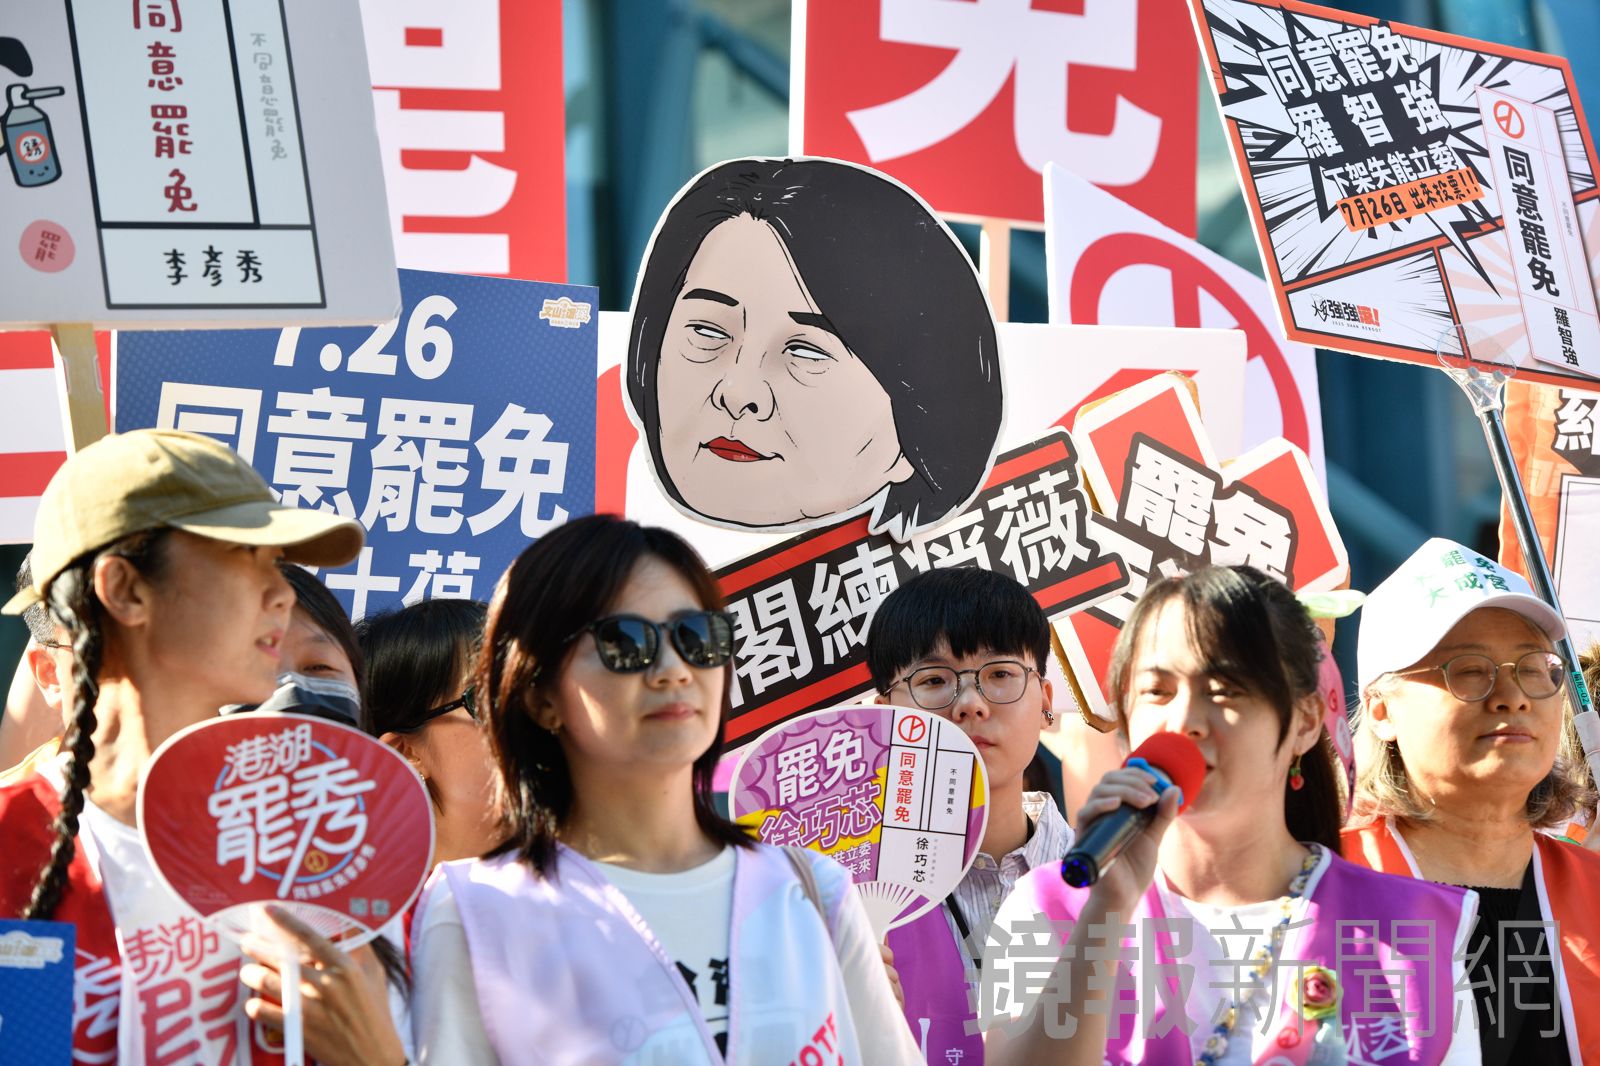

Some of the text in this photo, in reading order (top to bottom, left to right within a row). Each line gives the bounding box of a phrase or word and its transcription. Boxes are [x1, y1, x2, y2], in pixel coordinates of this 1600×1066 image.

[250, 33, 288, 160] 不同意罷免
[1257, 26, 1418, 103] 同意罷免
[133, 0, 199, 212] 同意罷免
[1287, 81, 1452, 159] 羅智強
[1323, 141, 1460, 197] 下架失能立委
[1340, 192, 1407, 227] 7月26日
[1503, 145, 1560, 297] 同意罷免
[35, 230, 61, 262] 罷
[163, 245, 263, 286] 李彥秀
[1553, 306, 1580, 367] 羅智強
[1124, 442, 1292, 584] 罷免
[224, 723, 312, 786] 港湖
[776, 730, 866, 806] 罷免
[895, 751, 916, 823] 同意罷免
[759, 783, 882, 849] 徐巧芯
[946, 768, 958, 815] 不同意罷免
[207, 758, 376, 899] 罷秀
[912, 837, 929, 883] 徐巧芯
